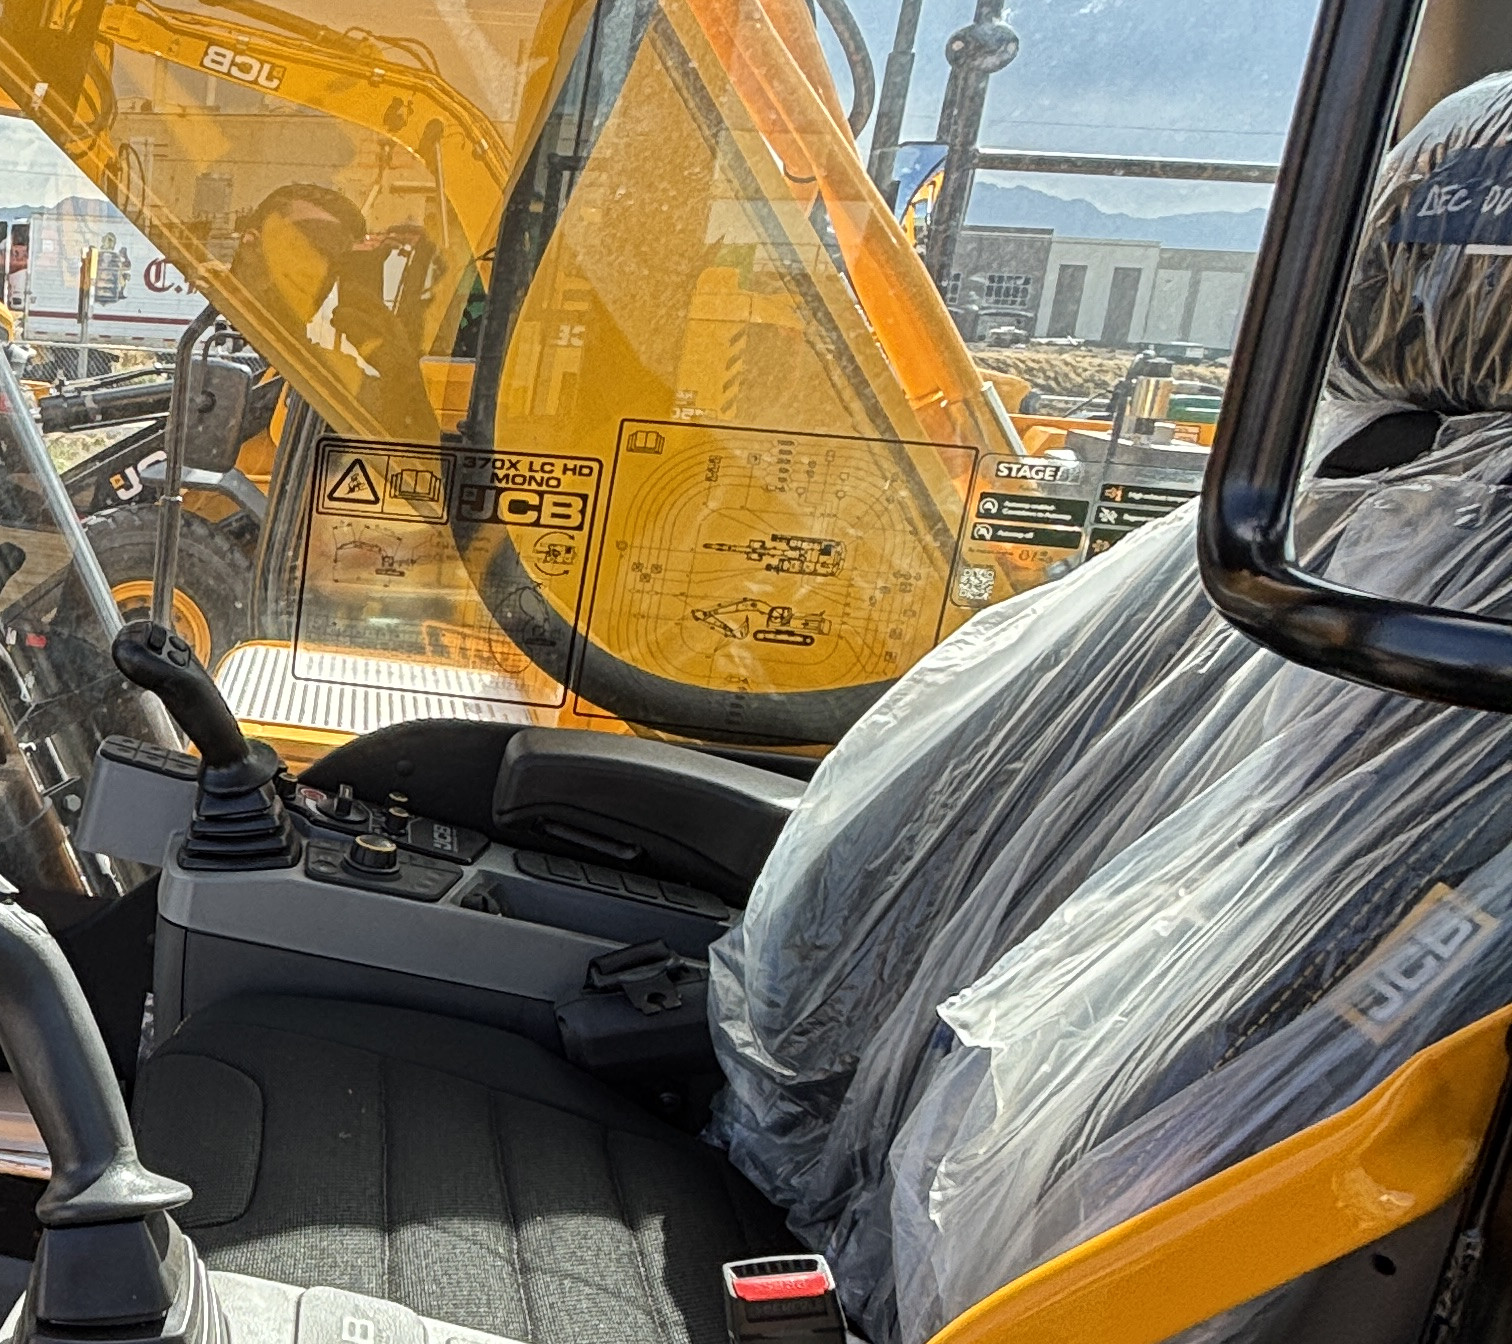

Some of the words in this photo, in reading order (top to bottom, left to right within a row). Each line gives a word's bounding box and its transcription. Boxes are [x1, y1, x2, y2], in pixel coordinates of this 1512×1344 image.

[462, 456, 522, 472] 370X
[527, 461, 556, 474] LC
[562, 462, 594, 477] HD
[996, 462, 1057, 482] STAGE
[490, 472, 562, 489] MONO
[460, 487, 584, 528] JCB
